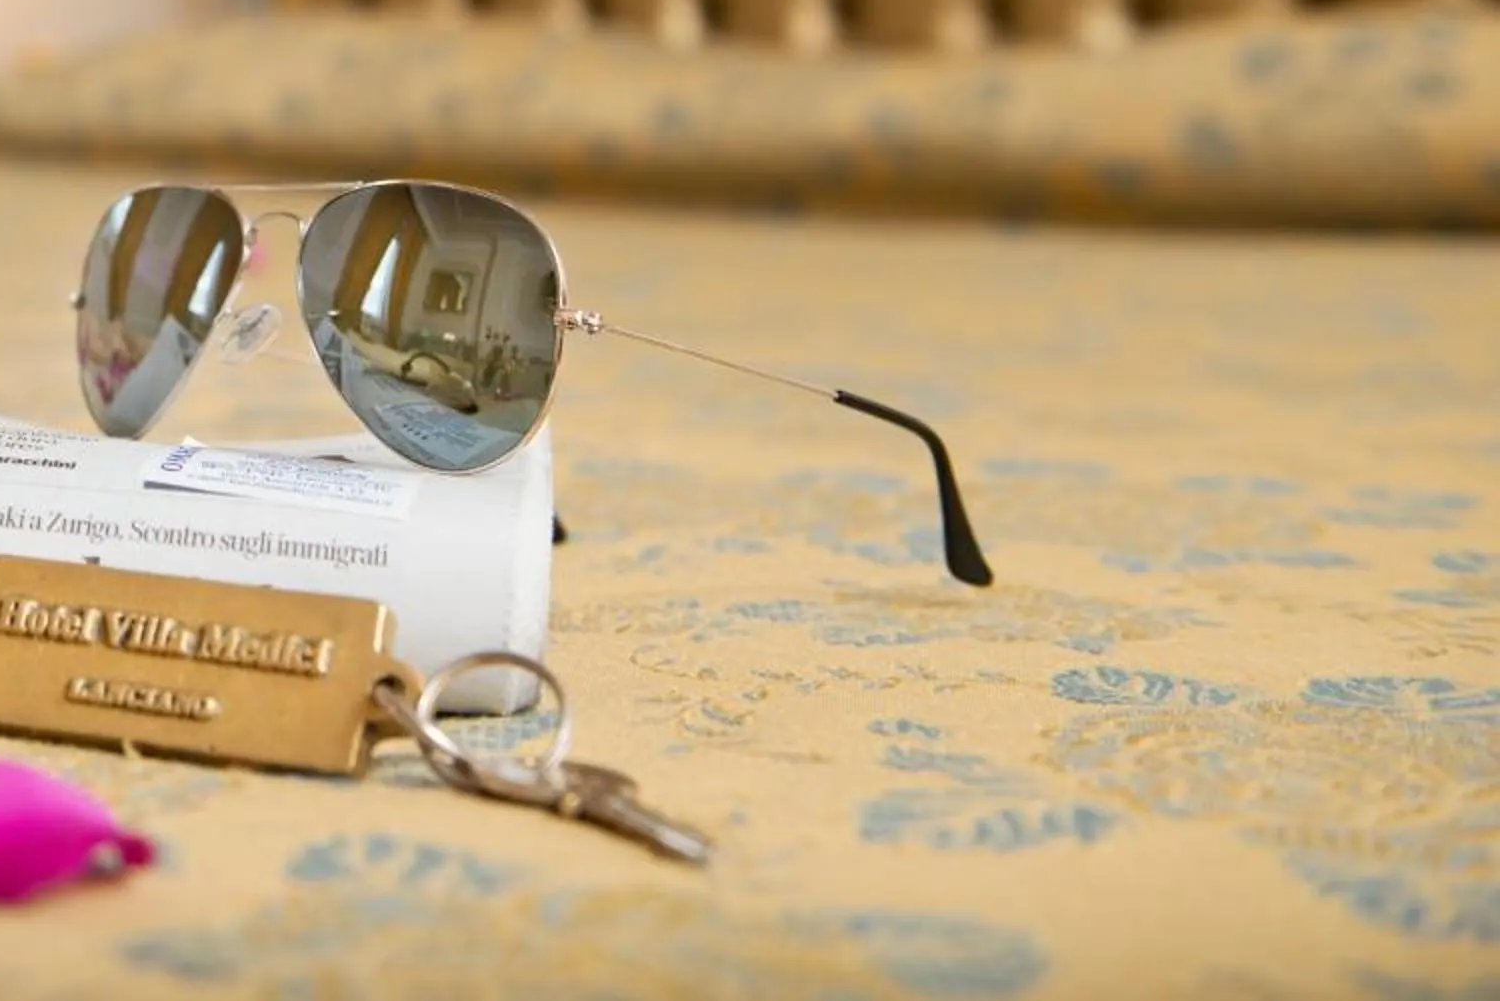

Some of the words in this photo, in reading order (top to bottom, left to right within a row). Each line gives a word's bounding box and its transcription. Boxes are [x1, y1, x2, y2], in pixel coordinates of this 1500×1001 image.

[28, 515, 42, 532] a
[129, 519, 216, 550] Scontro
[218, 530, 274, 562] sugli
[276, 537, 390, 569] immigrati
[103, 608, 199, 660] Villa
